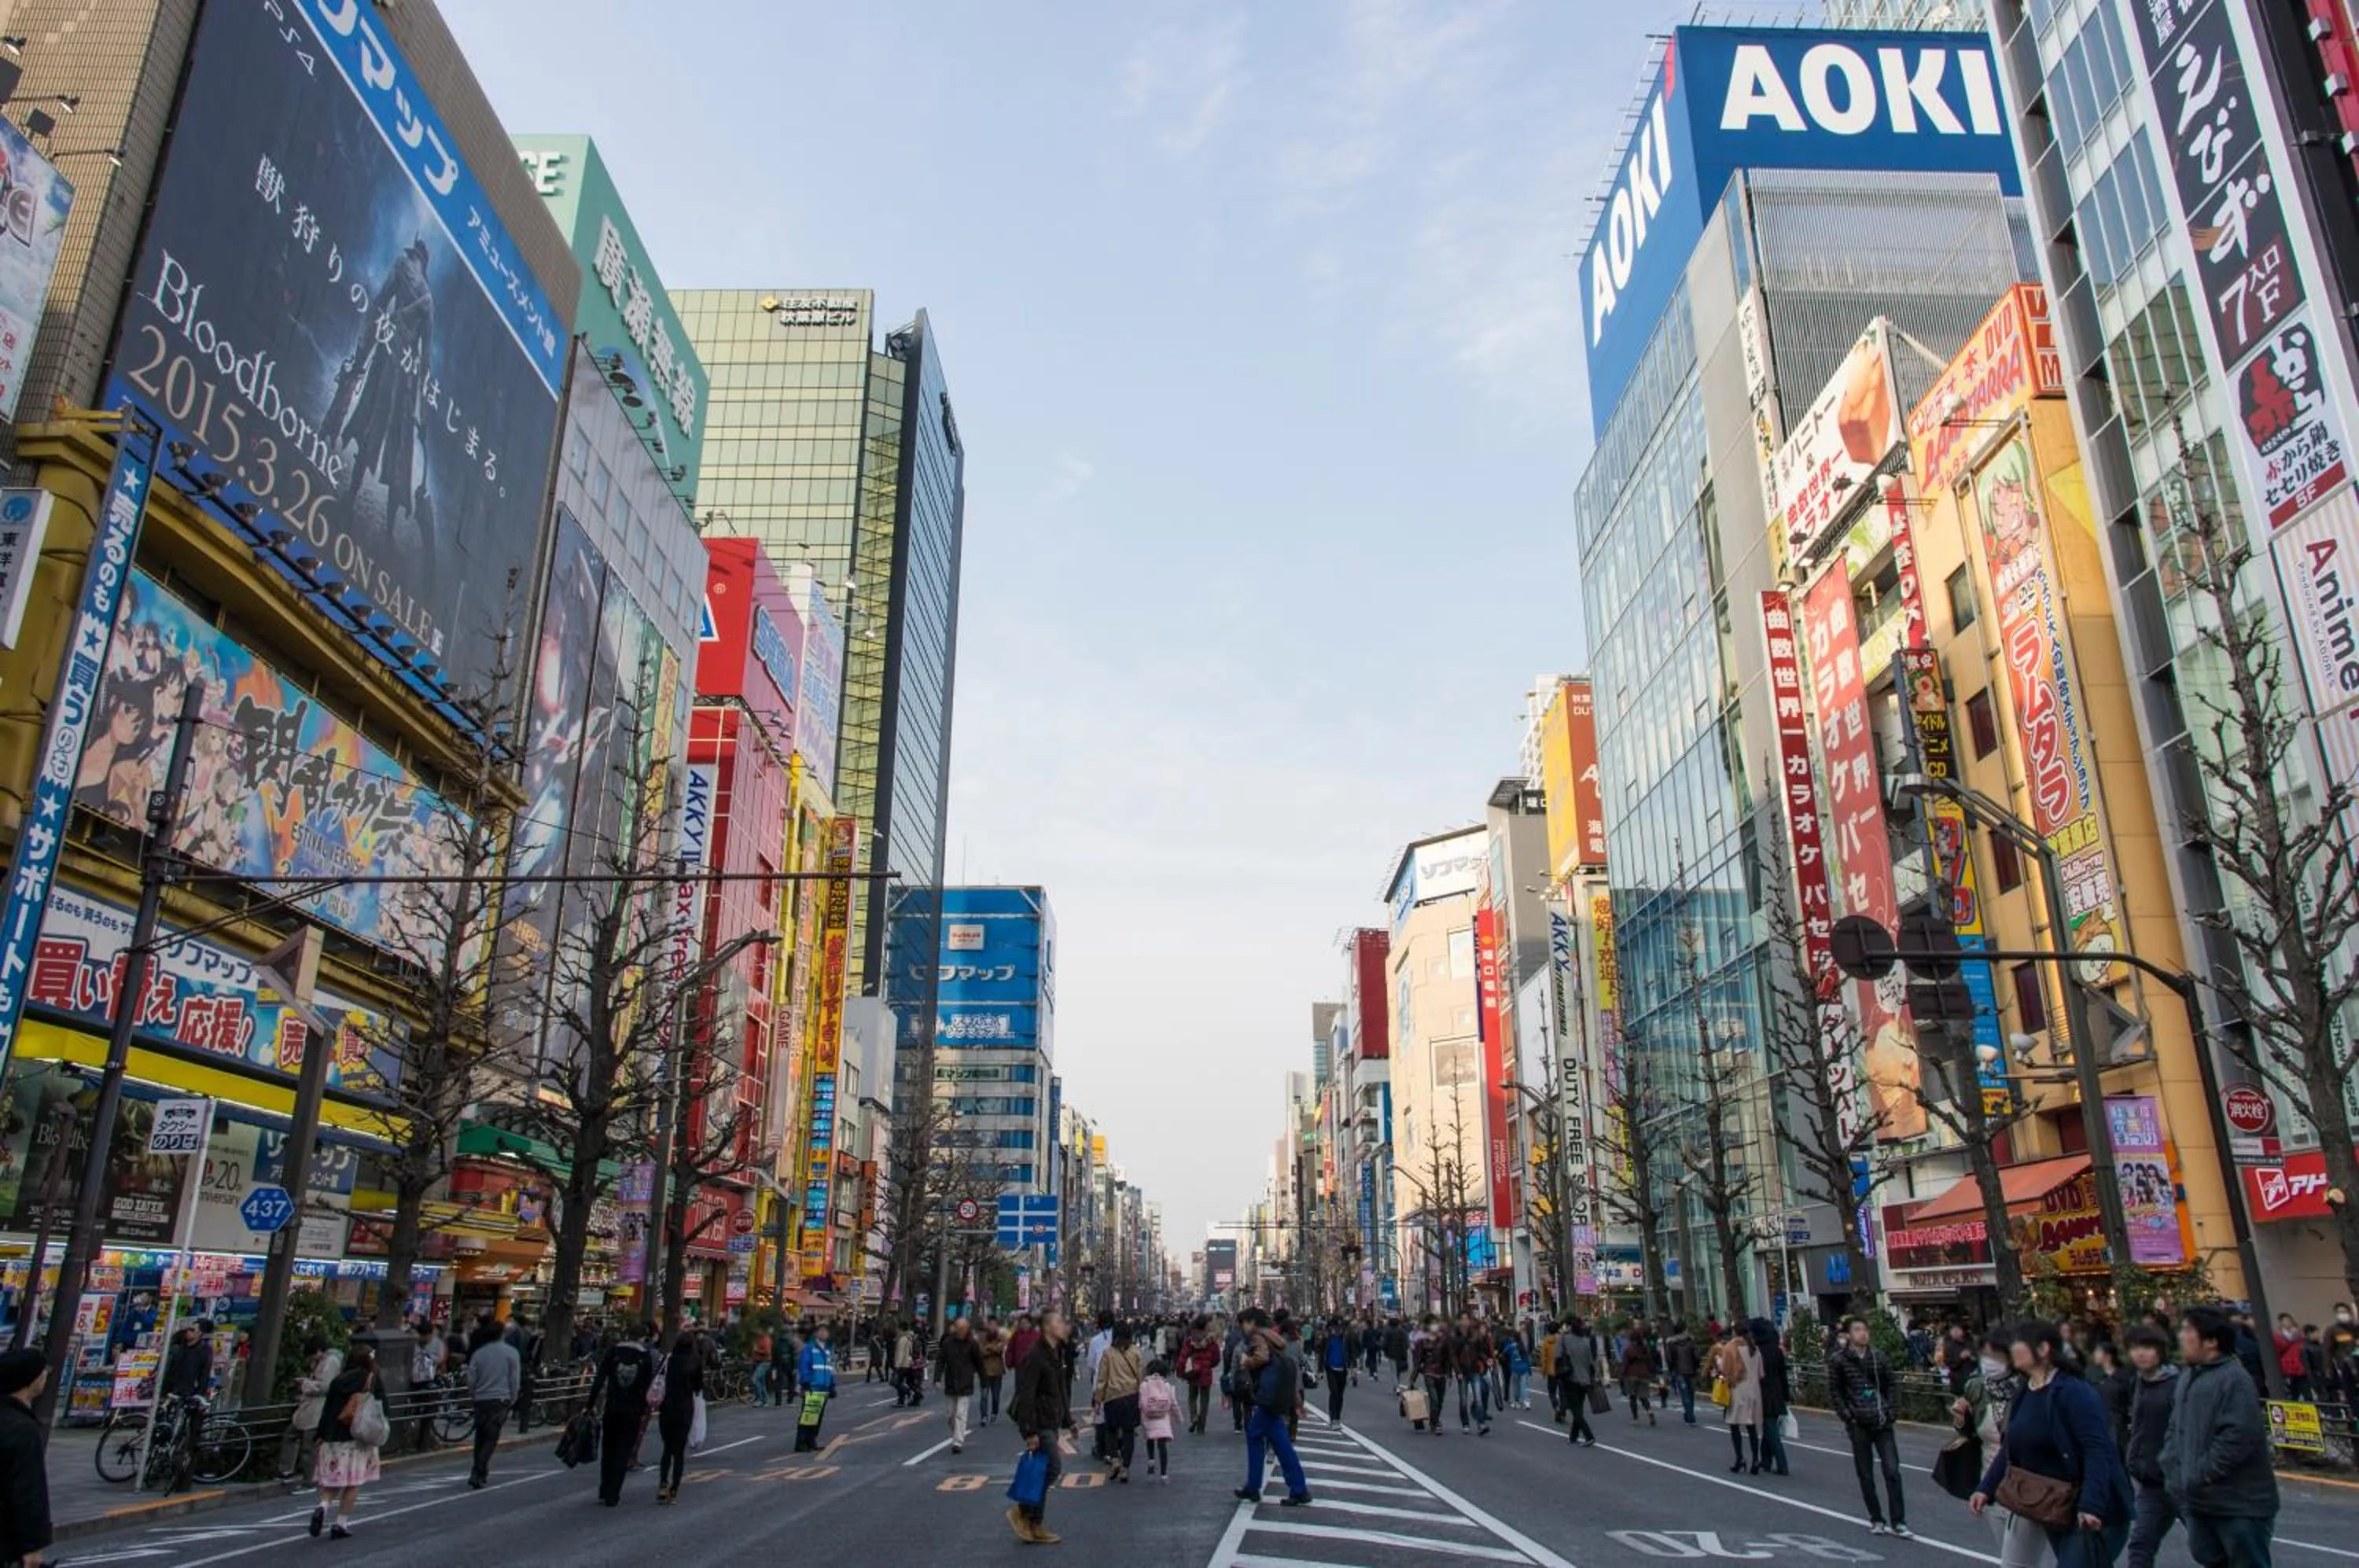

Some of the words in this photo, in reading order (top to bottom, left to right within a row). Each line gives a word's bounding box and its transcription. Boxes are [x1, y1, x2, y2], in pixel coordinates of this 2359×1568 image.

[1720, 43, 2002, 135] AOKI
[1592, 91, 1672, 348] AOKI
[138, 248, 346, 490] Bloodborne
[128, 322, 338, 550] 2015.3.26
[334, 535, 374, 589] ON
[372, 570, 435, 649] SALE
[2306, 537, 2359, 693] Anime
[1766, 608, 1805, 736] 曲数世界一
[1787, 754, 1820, 865] カラオケ
[1810, 621, 1849, 804] カラオケ
[1841, 812, 1871, 914] パセ
[1927, 761, 1947, 778] CD
[683, 769, 708, 847] AKKY
[82, 909, 119, 931] 買うのも
[1550, 911, 1571, 973] AKKY
[1551, 957, 1568, 1036] International
[175, 994, 254, 1056] 応援!
[776, 1010, 791, 1050] GAME
[1562, 1058, 1579, 1109] DUTY
[157, 1121, 198, 1133] タクシー
[2229, 1103, 2265, 1119] 消火栓
[153, 1135, 197, 1149] のりば
[1567, 1116, 1584, 1165] FREE
[245, 1199, 287, 1217] 437
[1573, 1172, 1590, 1225] SOP
[2045, 1183, 2084, 1214] DVD
[936, 1473, 1106, 1492] 8-0
